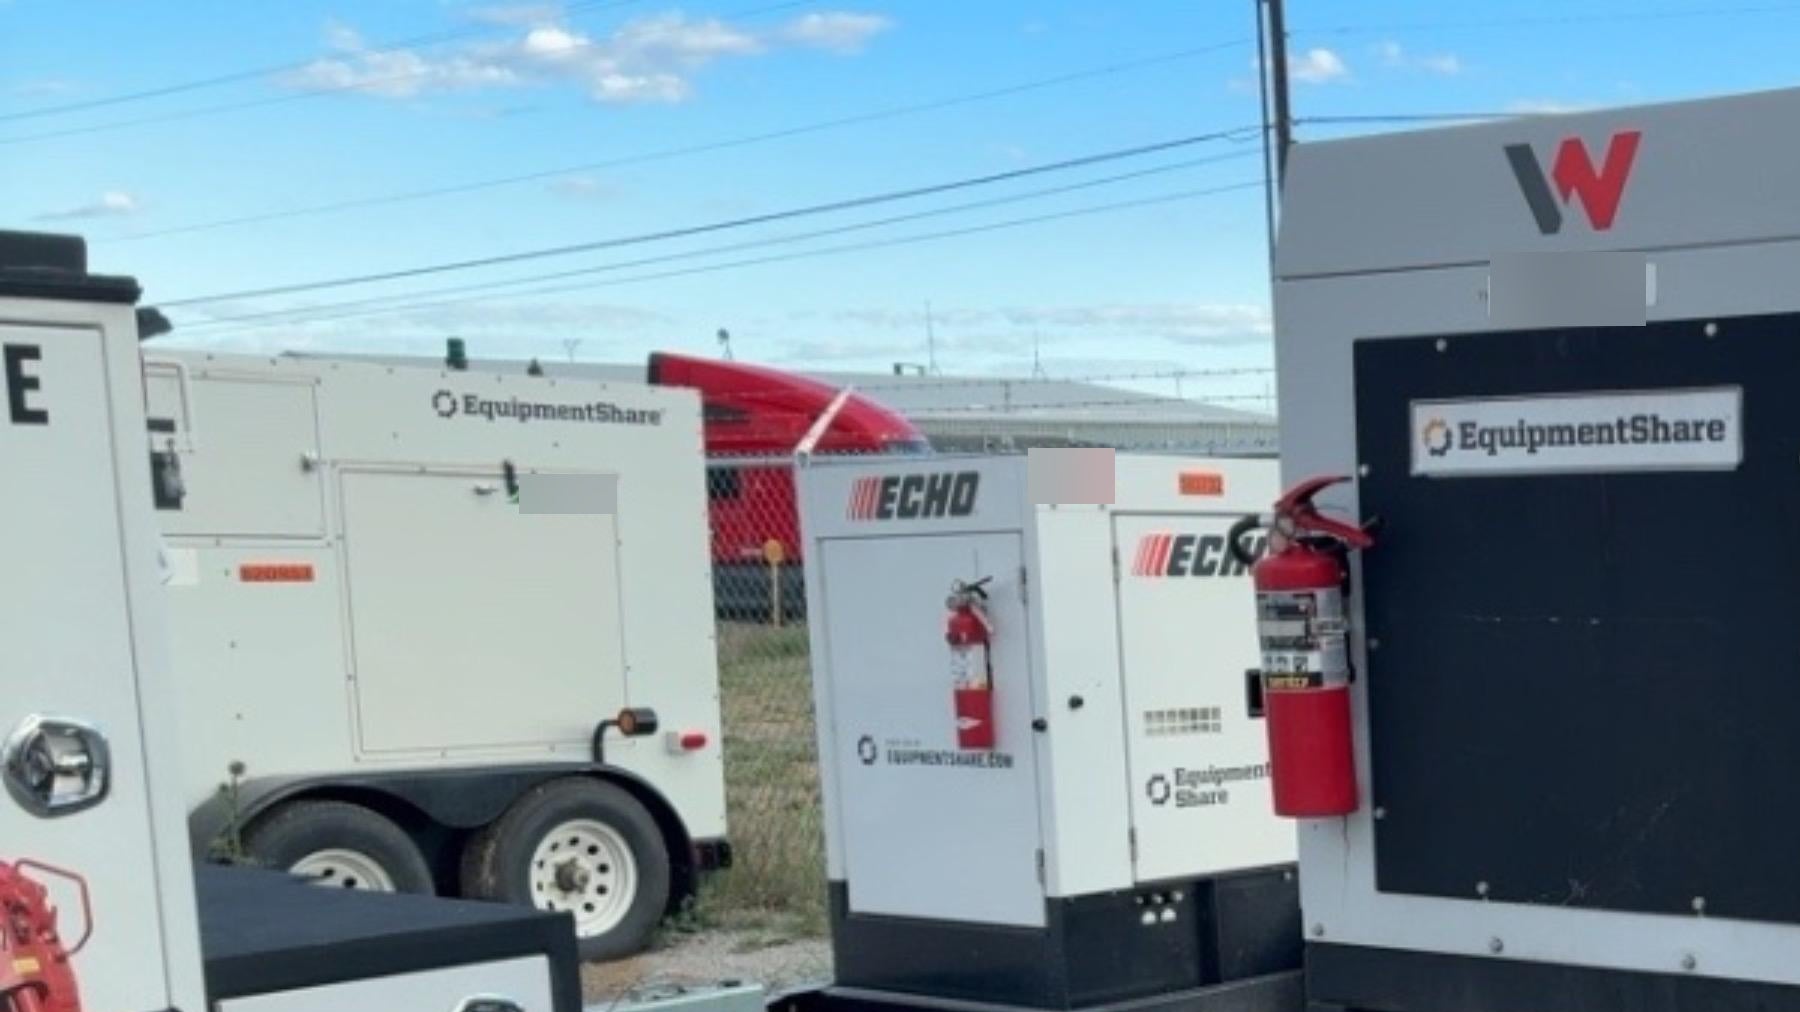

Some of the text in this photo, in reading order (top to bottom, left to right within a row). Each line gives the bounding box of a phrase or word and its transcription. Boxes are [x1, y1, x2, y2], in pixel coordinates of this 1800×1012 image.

[462, 394, 662, 426] EquipmentShare
[1458, 414, 1726, 455] EquipmentShare
[876, 470, 980, 519] ECHO
[1175, 788, 1229, 808] Share
